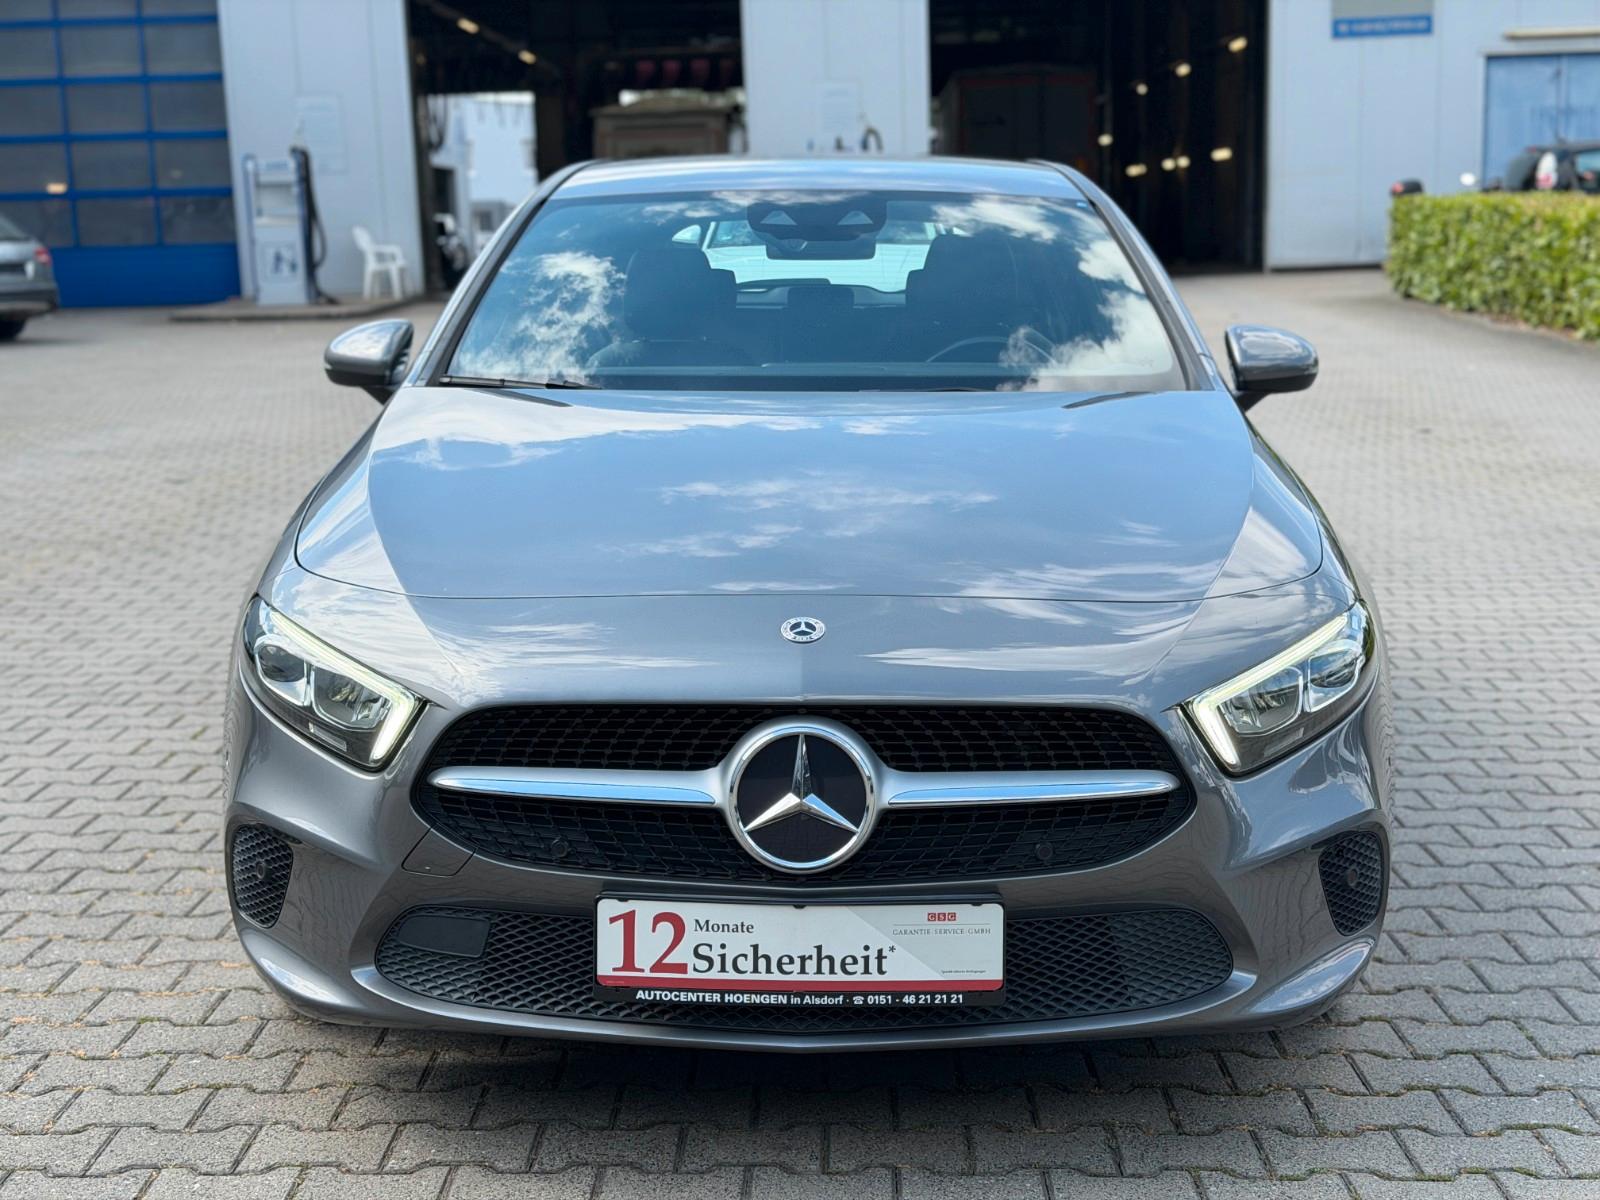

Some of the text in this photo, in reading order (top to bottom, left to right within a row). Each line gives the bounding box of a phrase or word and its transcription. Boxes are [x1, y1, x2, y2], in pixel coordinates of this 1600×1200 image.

[694, 918, 754, 933] Monate
[892, 928, 931, 936] GARANTIE
[968, 927, 991, 935] GMBH
[609, 909, 688, 974] 12
[635, 989, 721, 1004] AUTOCENTER
[724, 993, 787, 1005] HOENGEN
[790, 994, 801, 1005] in
[803, 994, 844, 1006] Alsdorf
[867, 994, 892, 1005] 0151
[902, 994, 916, 1005] 46
[918, 994, 931, 1005] 21
[934, 993, 947, 1005] 21
[950, 993, 963, 1004] 21
